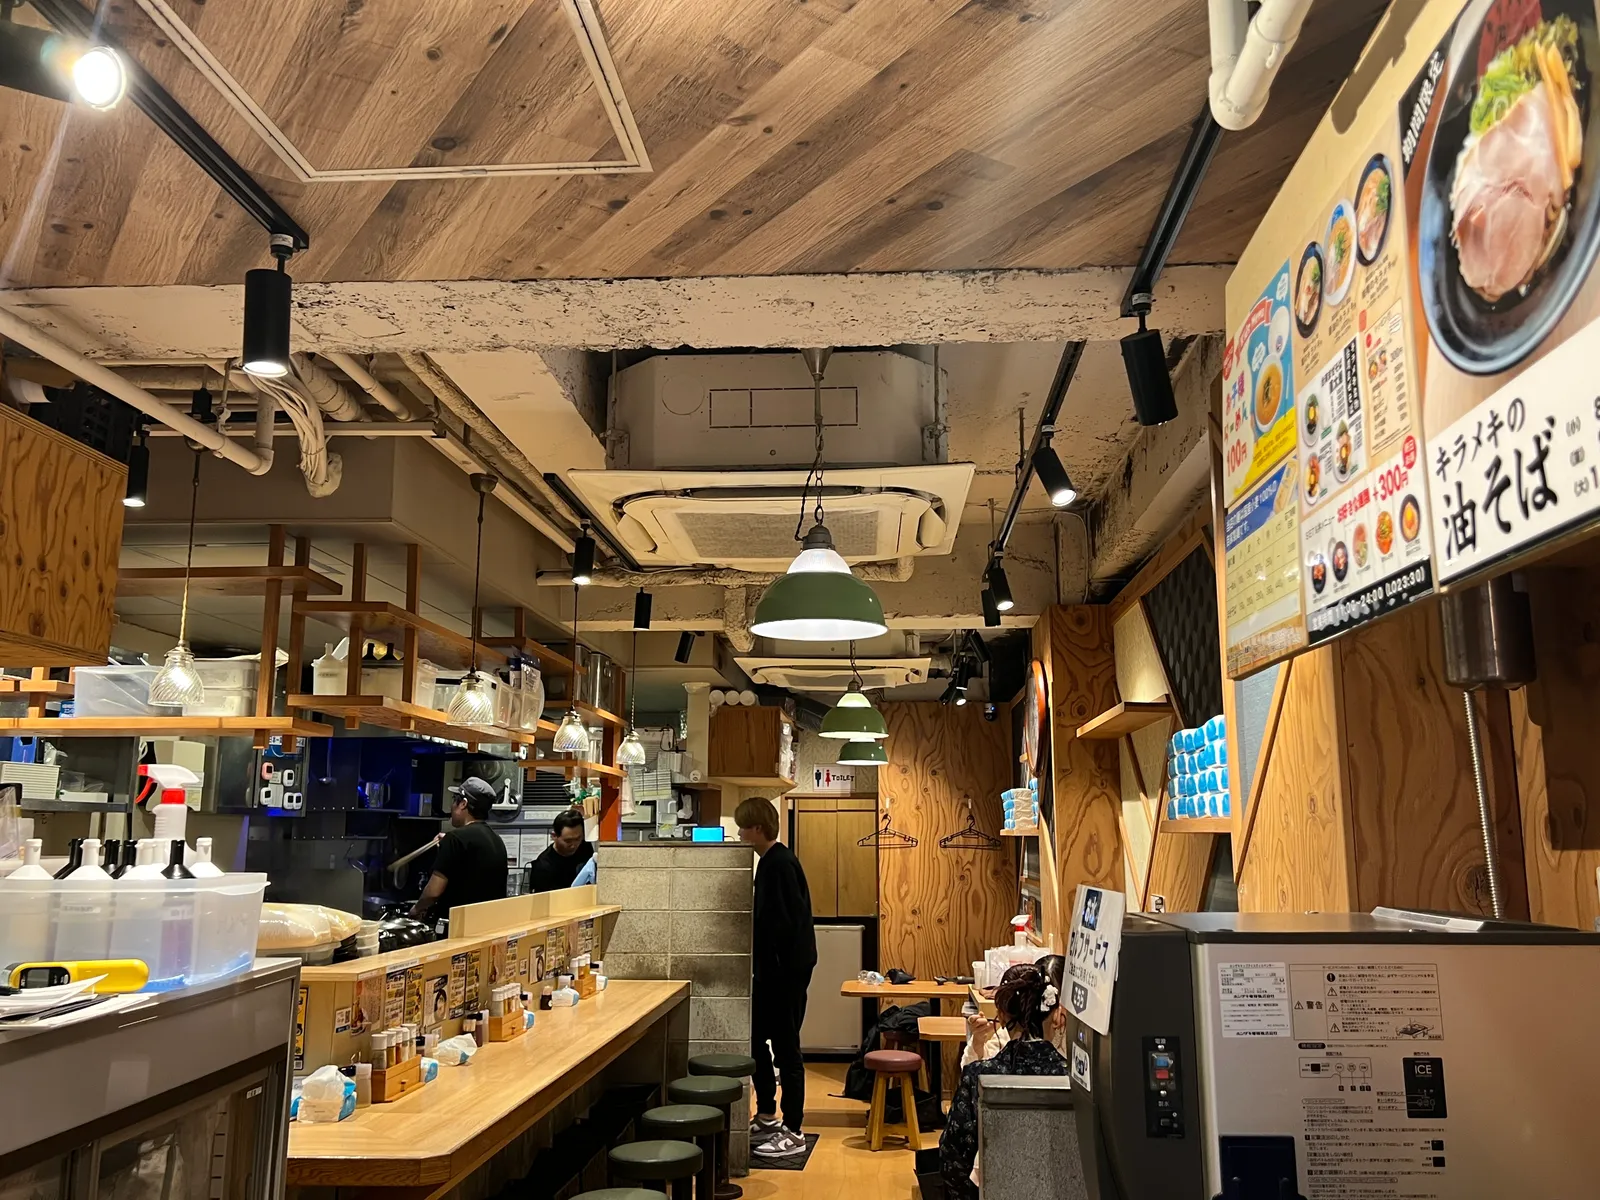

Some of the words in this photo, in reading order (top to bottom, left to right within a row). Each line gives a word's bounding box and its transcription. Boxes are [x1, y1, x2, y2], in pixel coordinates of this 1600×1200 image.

[1402, 51, 1444, 164] 期間限定
[1227, 438, 1247, 477] 100円
[1436, 397, 1525, 482] キラメキの
[1442, 415, 1558, 560] 油そば
[1070, 931, 1109, 972] セルフサービス
[1306, 1000, 1323, 1010] 警告
[1415, 1064, 1433, 1075] ICE
